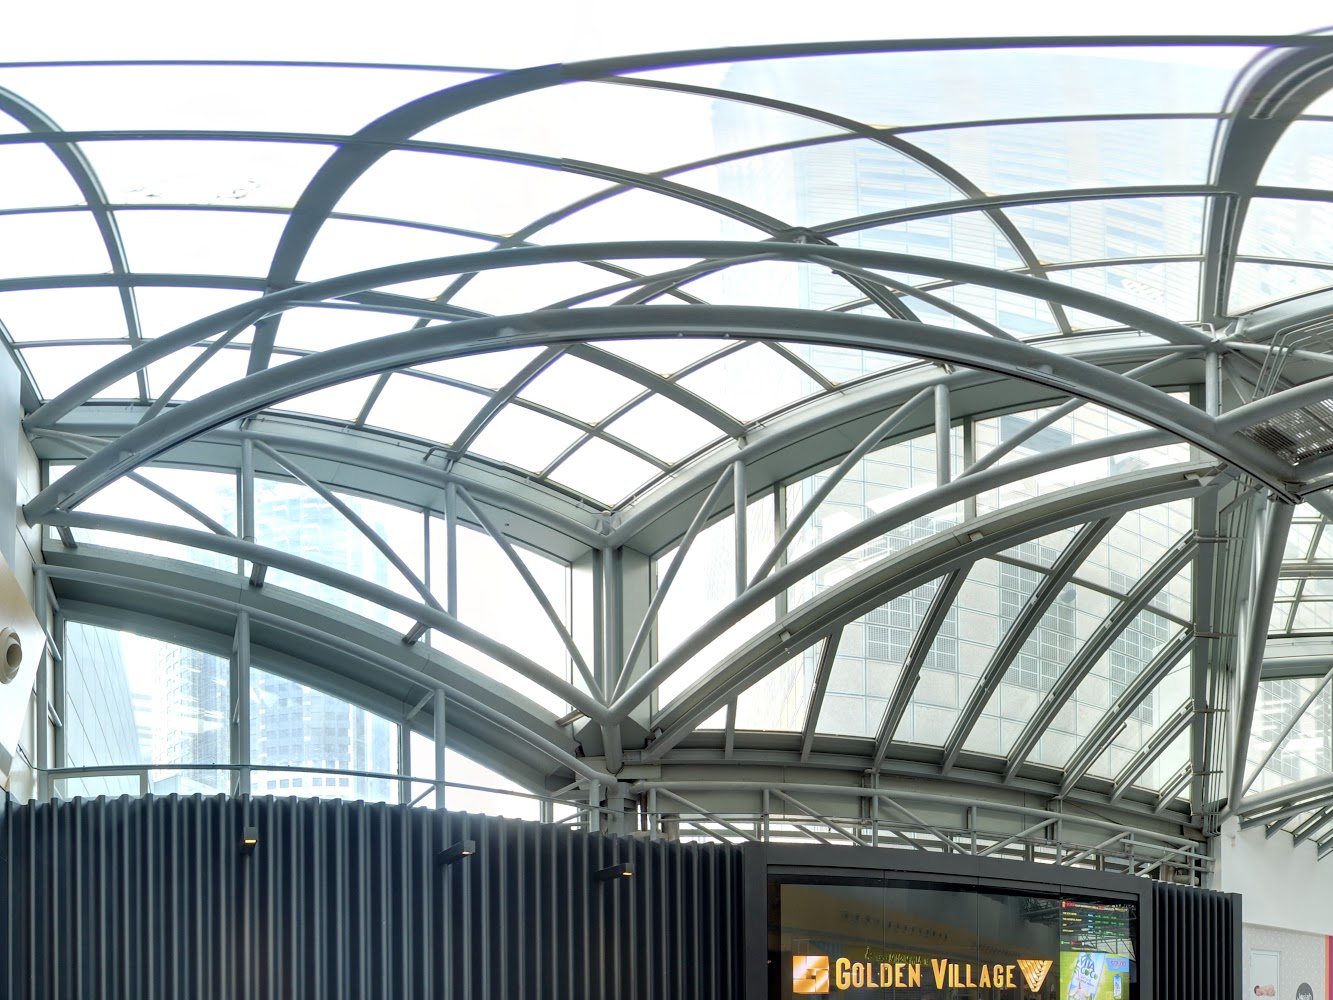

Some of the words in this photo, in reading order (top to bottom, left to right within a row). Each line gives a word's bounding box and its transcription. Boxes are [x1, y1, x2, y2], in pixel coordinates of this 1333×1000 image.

[835, 957, 921, 990] GOLDEN
[931, 958, 1017, 990] VILLAGE
[1081, 956, 1095, 972] VITA
